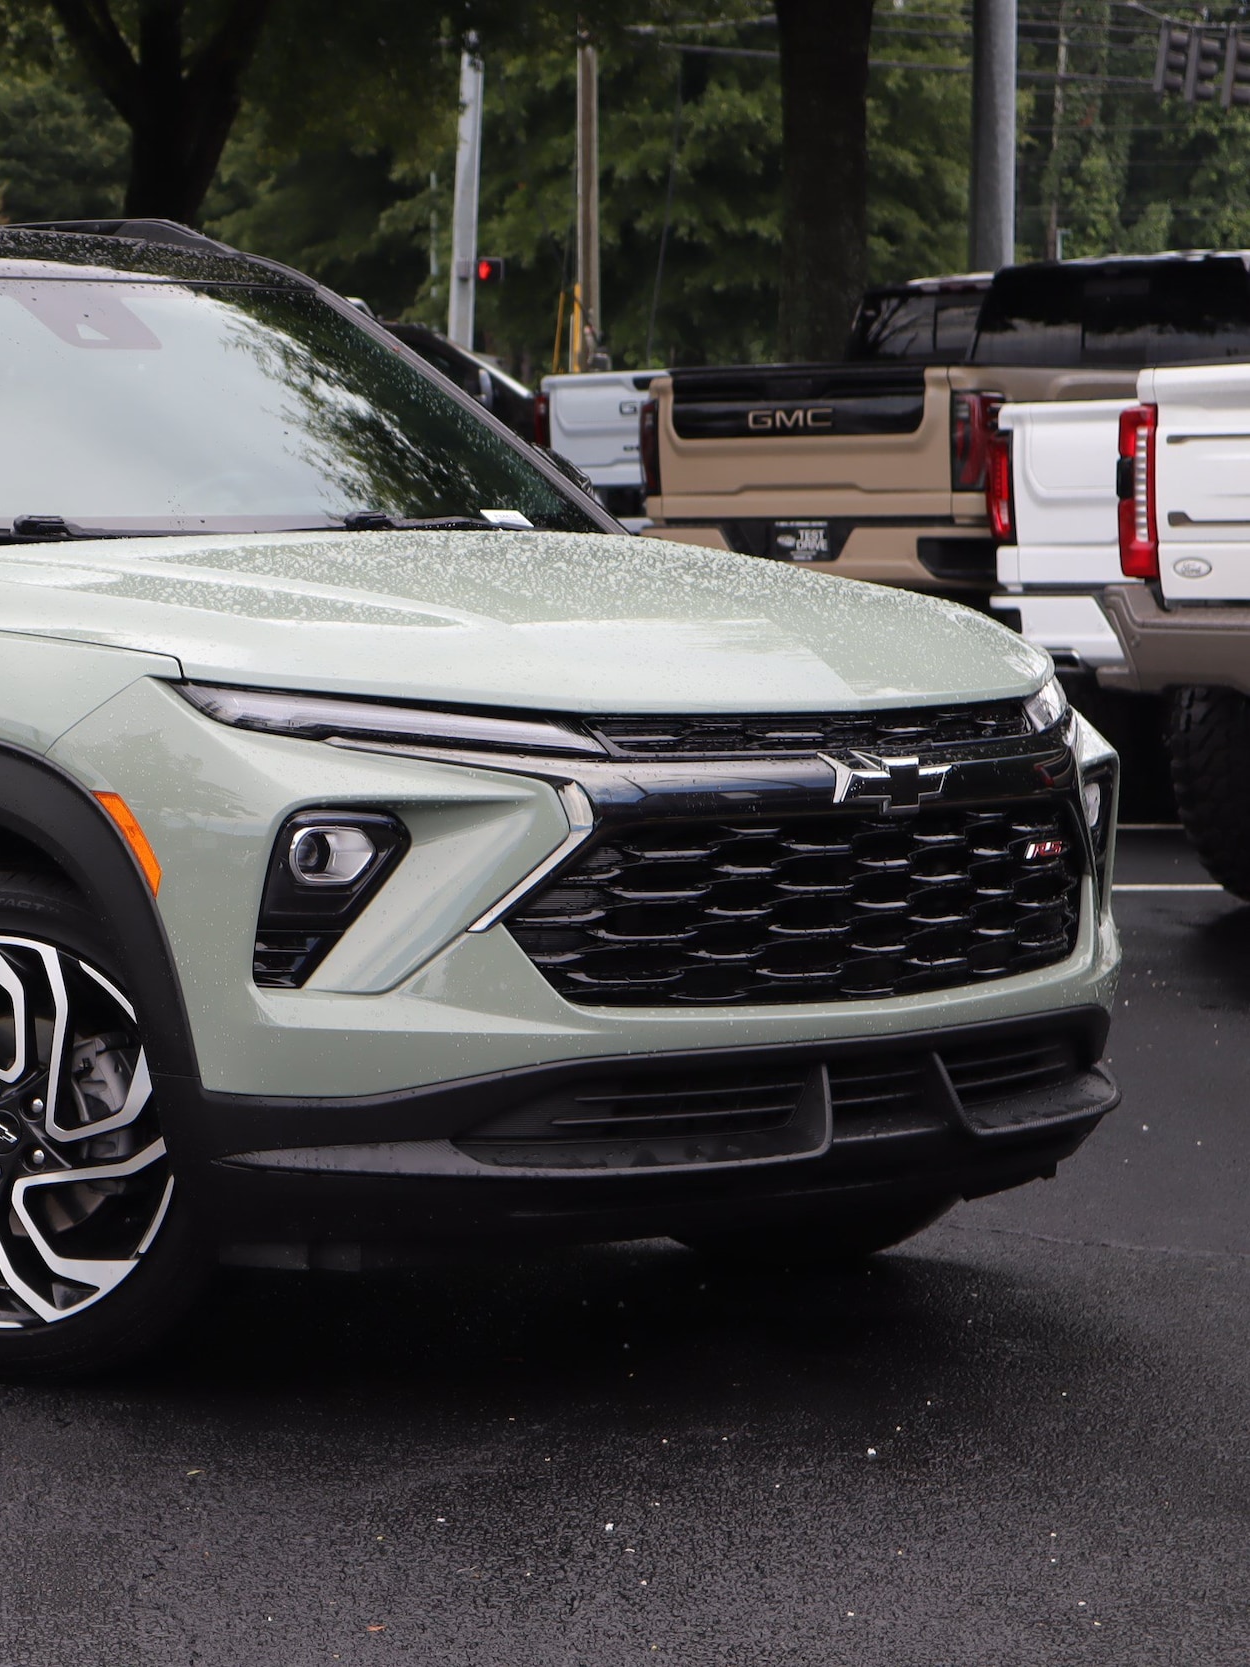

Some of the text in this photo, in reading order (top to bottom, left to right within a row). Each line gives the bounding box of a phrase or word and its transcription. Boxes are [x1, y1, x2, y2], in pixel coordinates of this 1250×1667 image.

[748, 407, 833, 429] GMC
[798, 529, 824, 540] TEST
[796, 539, 828, 551] DRIVE
[1026, 841, 1063, 859] RS
